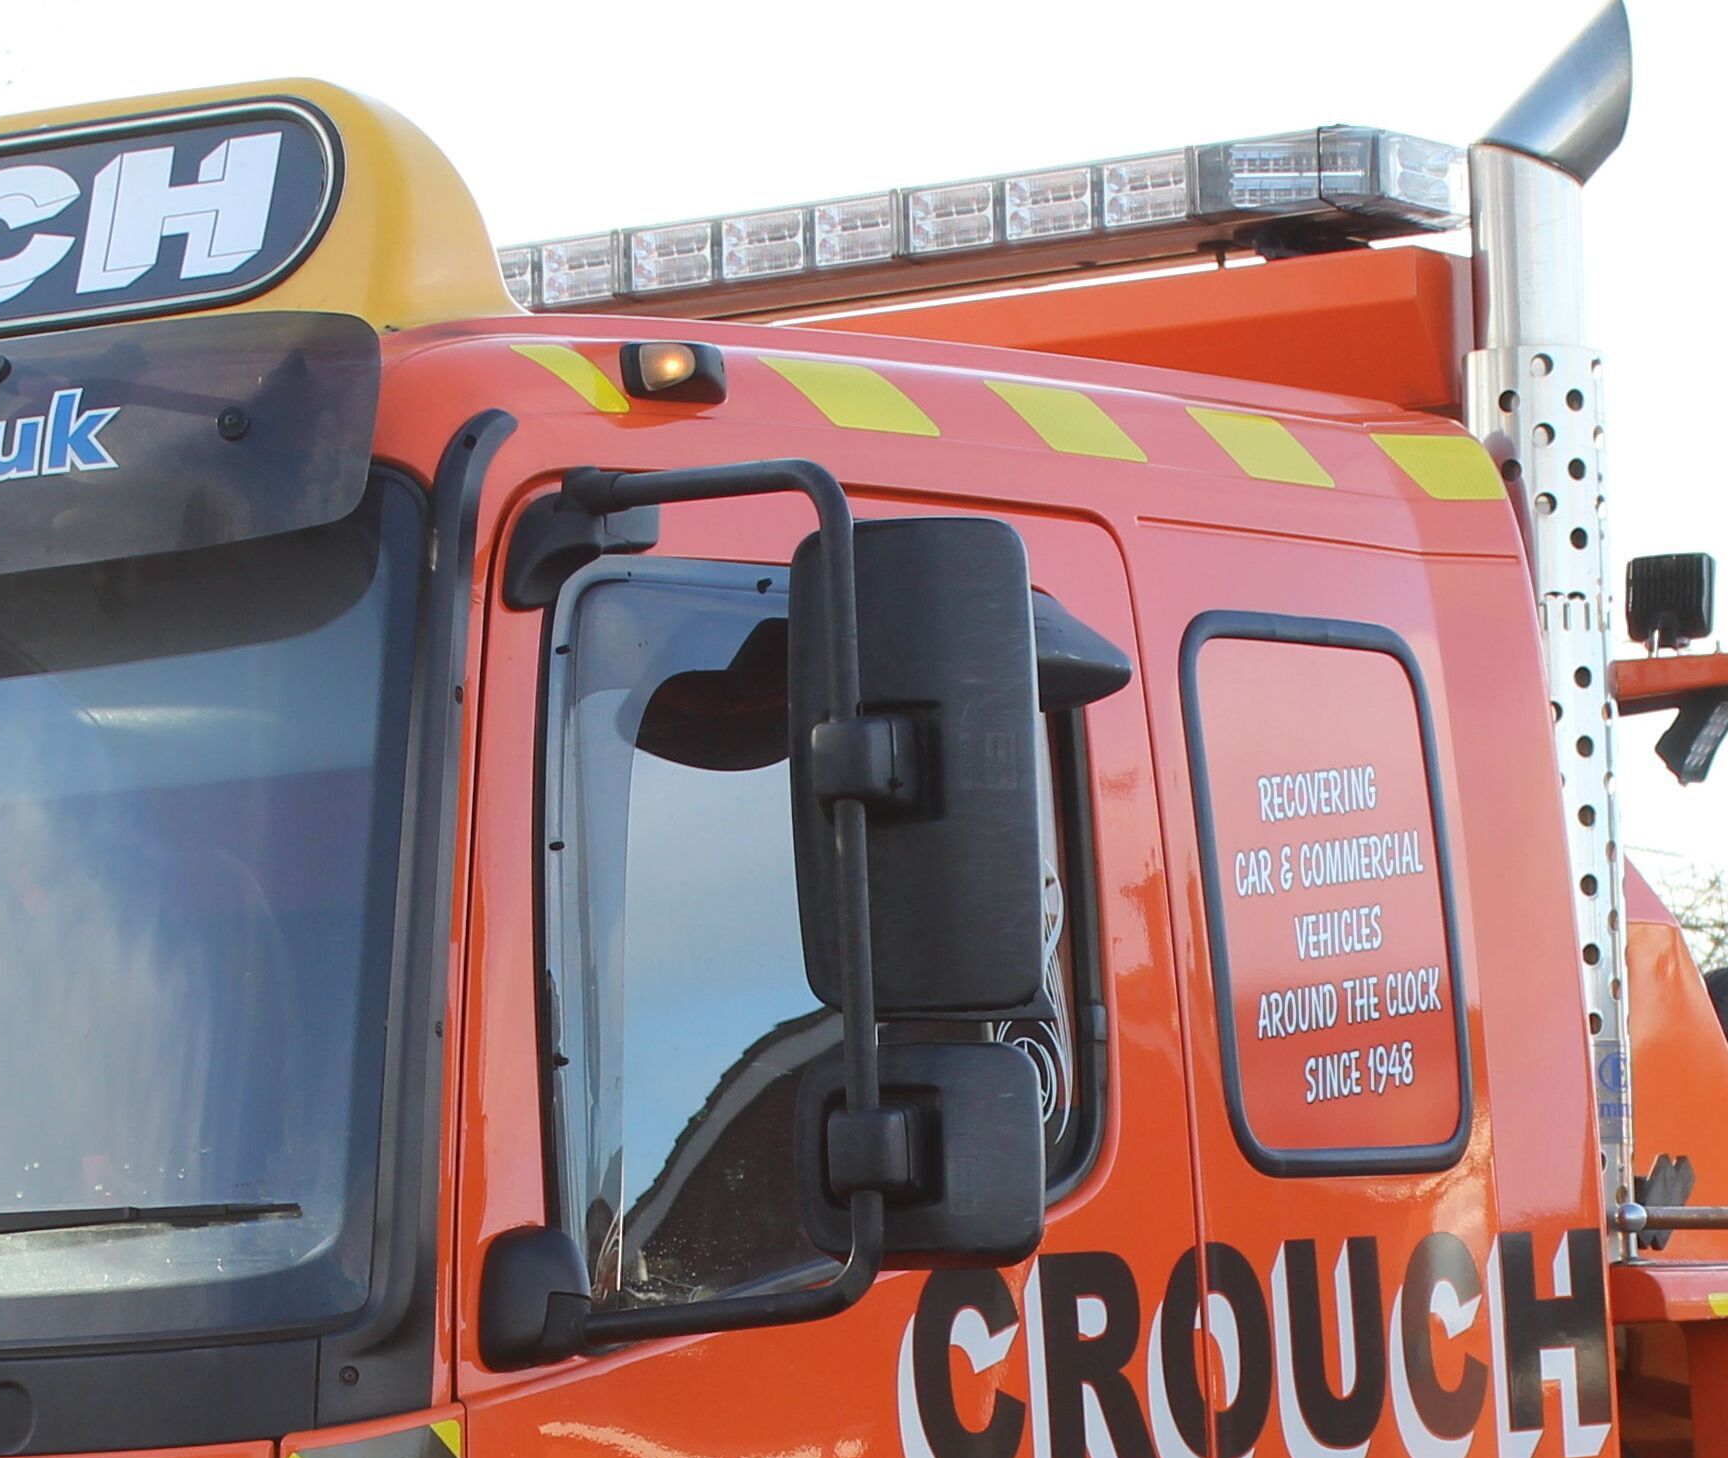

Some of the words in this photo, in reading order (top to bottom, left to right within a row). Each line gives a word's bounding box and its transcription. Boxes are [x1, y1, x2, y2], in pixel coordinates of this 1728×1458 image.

[1257, 765, 1377, 823] RECOVERING
[1234, 848, 1276, 897] CAR
[1279, 845, 1294, 891] &
[1299, 829, 1424, 888] COMMERCIAL
[1293, 903, 1383, 960] VEHICLES
[1257, 983, 1338, 1040] AROUND
[1341, 976, 1381, 1025] THE
[1385, 967, 1442, 1018] CLOCK
[1304, 1050, 1362, 1105] SINCE
[1367, 1040, 1415, 1096] 1948
